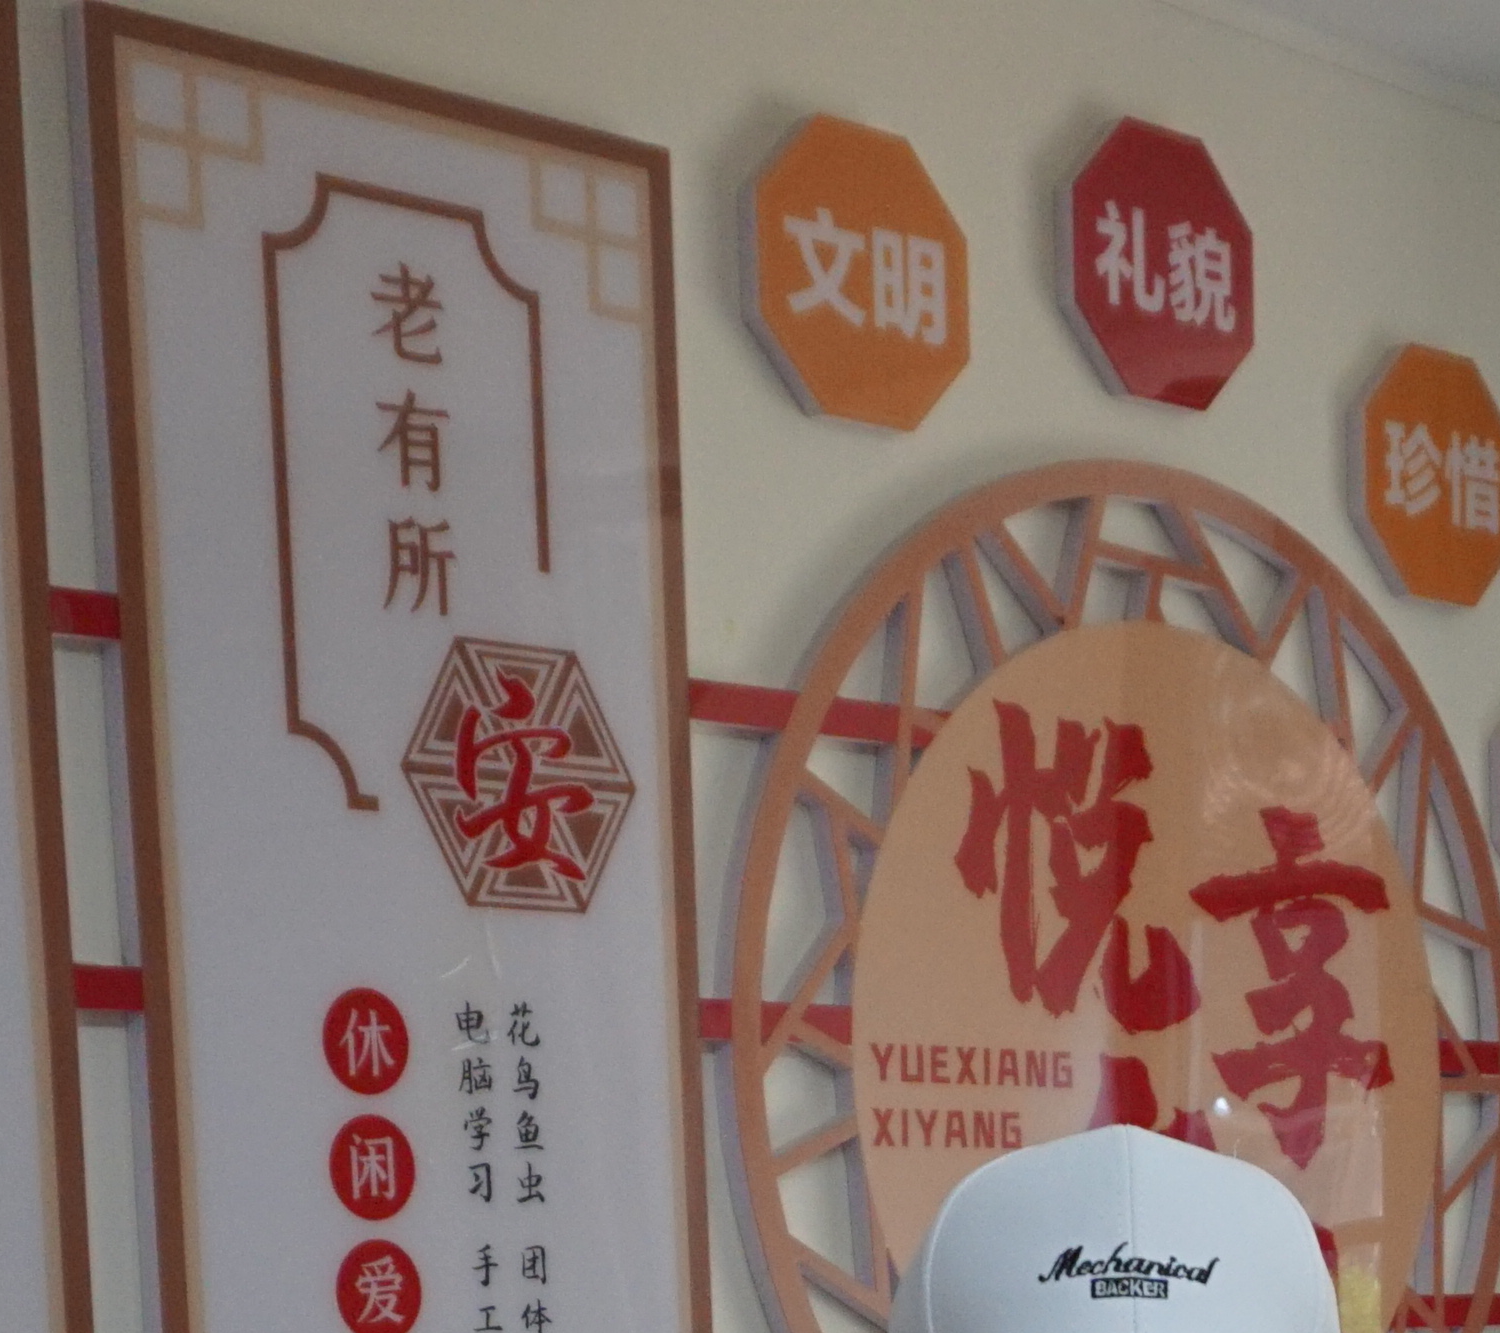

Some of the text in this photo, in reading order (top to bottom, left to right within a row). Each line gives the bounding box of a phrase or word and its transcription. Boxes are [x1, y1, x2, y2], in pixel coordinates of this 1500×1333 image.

[784, 206, 949, 346] 文明
[1095, 200, 1237, 334] 礼貌
[371, 261, 457, 616] 老有所
[453, 666, 595, 881] 安
[954, 698, 1395, 1170] 悦享
[454, 1001, 494, 1204] 电脑学习
[507, 1002, 547, 1204] 花鸟鱼虫
[870, 1042, 1074, 1089] YUEXIANG
[871, 1105, 1023, 1150] XIYANG
[1038, 1241, 1220, 1286] Mechanical
